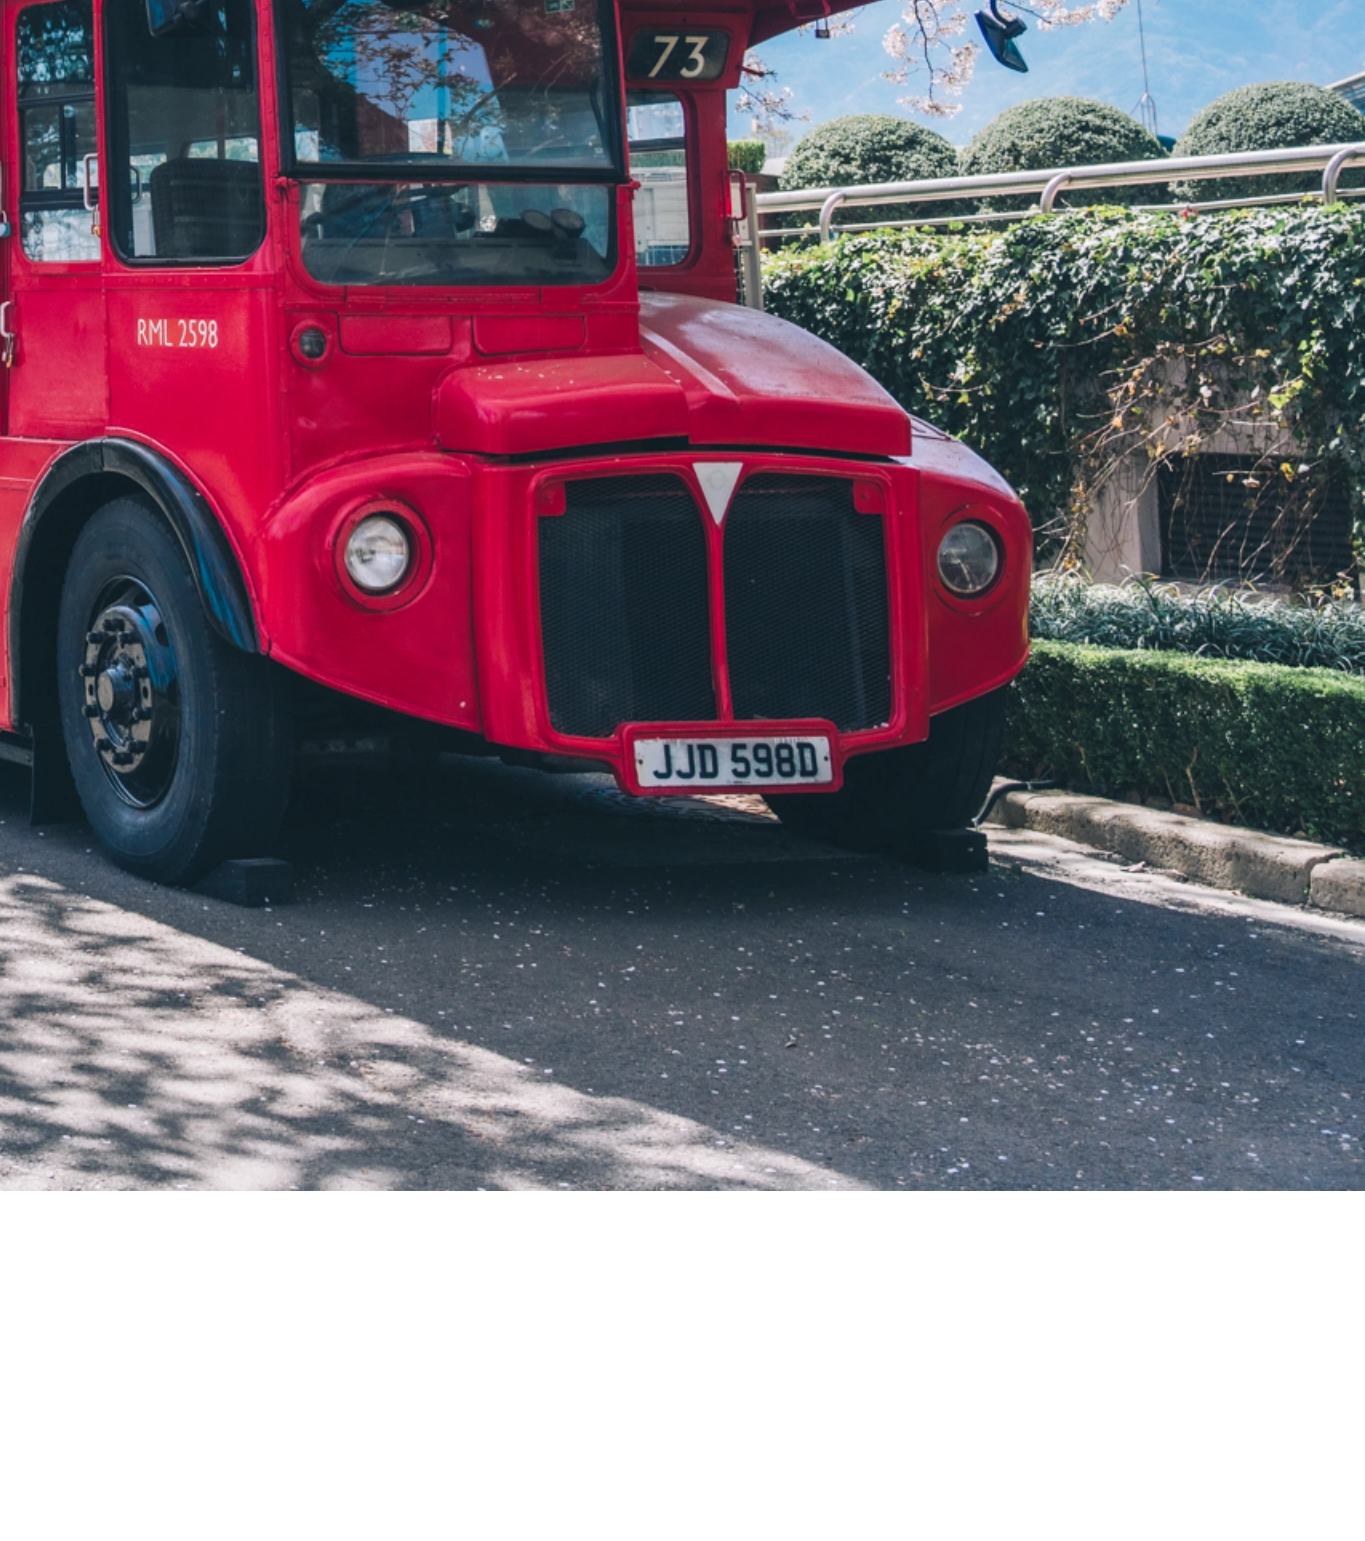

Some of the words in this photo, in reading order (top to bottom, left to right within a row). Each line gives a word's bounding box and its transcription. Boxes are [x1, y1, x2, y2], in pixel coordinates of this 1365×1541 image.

[647, 35, 709, 78] 73
[137, 318, 174, 348] RML
[177, 318, 219, 349] 2598
[653, 743, 719, 779] JJD
[730, 742, 819, 778] 598D
